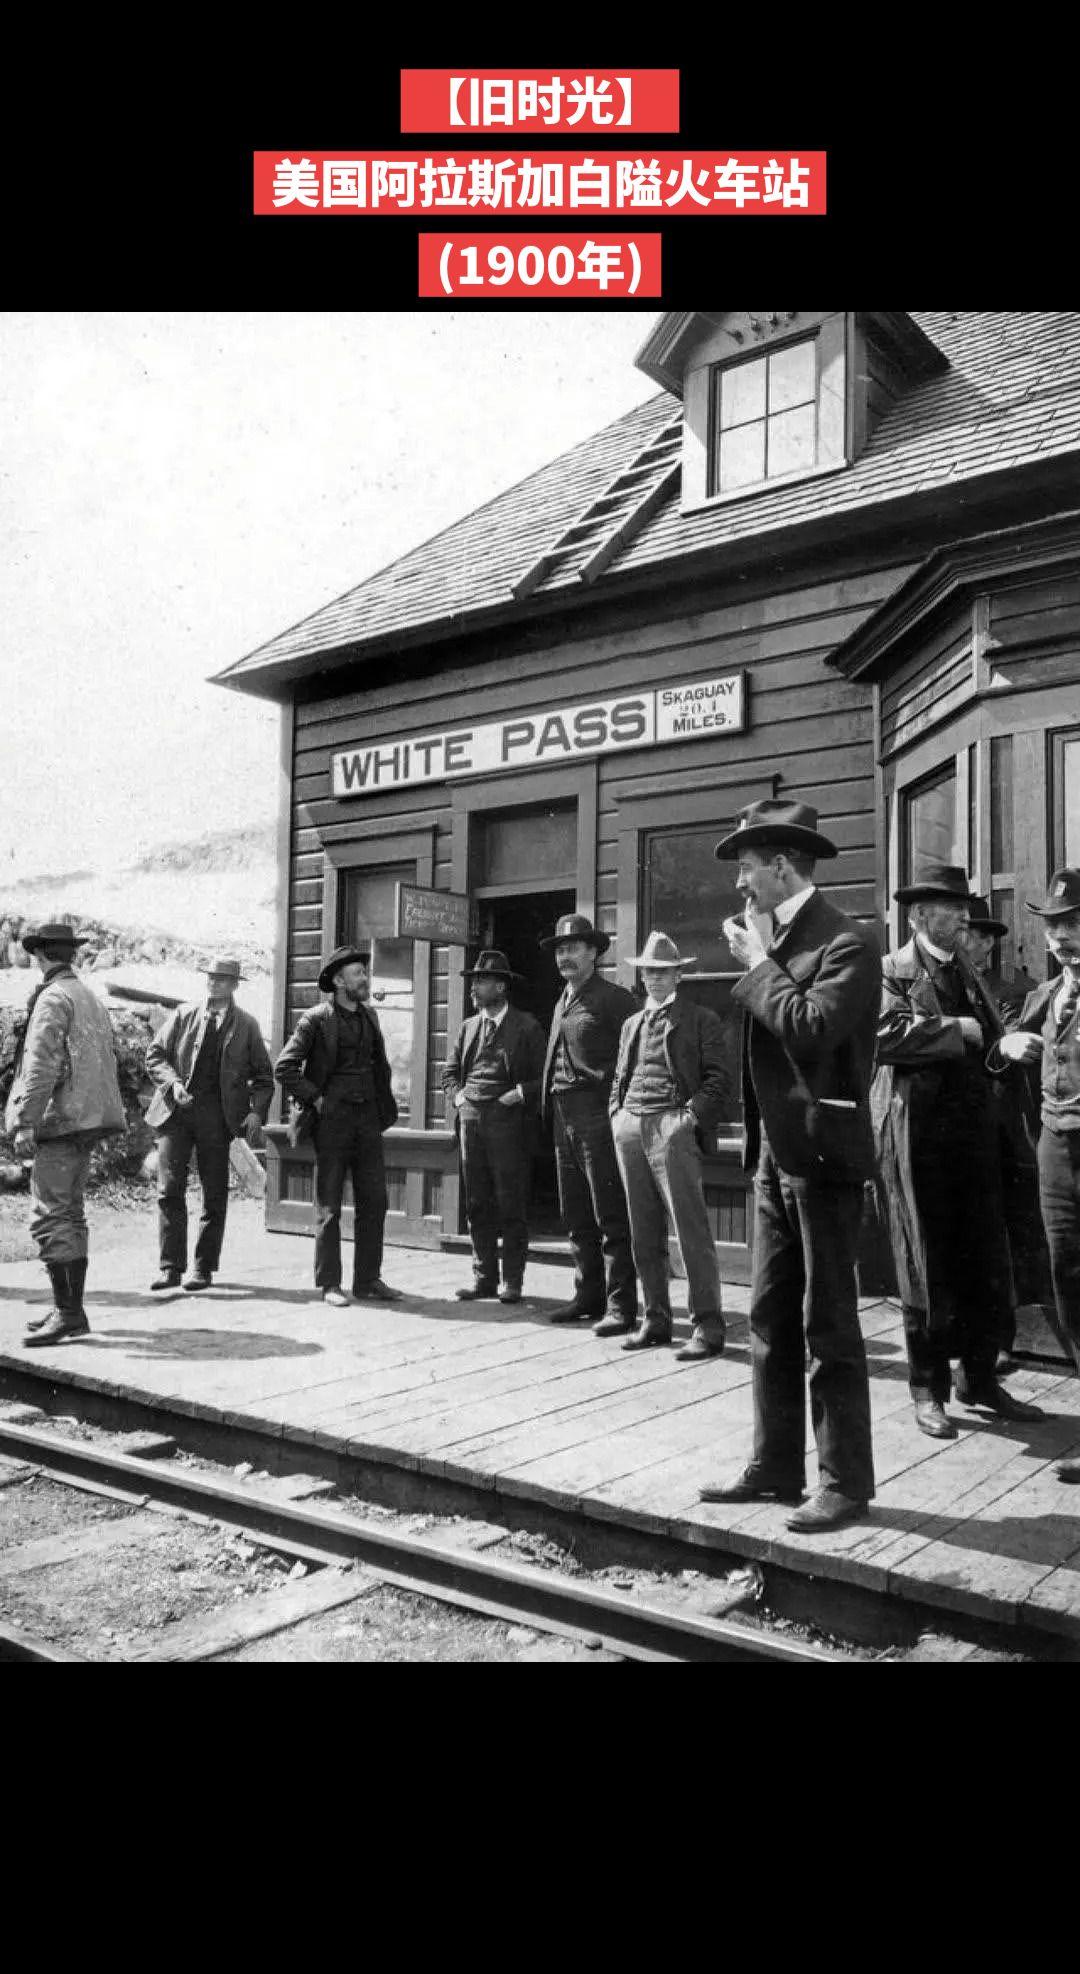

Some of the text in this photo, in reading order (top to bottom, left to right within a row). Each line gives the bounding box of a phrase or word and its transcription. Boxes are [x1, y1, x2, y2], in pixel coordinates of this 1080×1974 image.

[662, 682, 735, 706] SKAGUAY
[673, 713, 732, 733] MILES.
[342, 701, 646, 790] WHITE PASS
